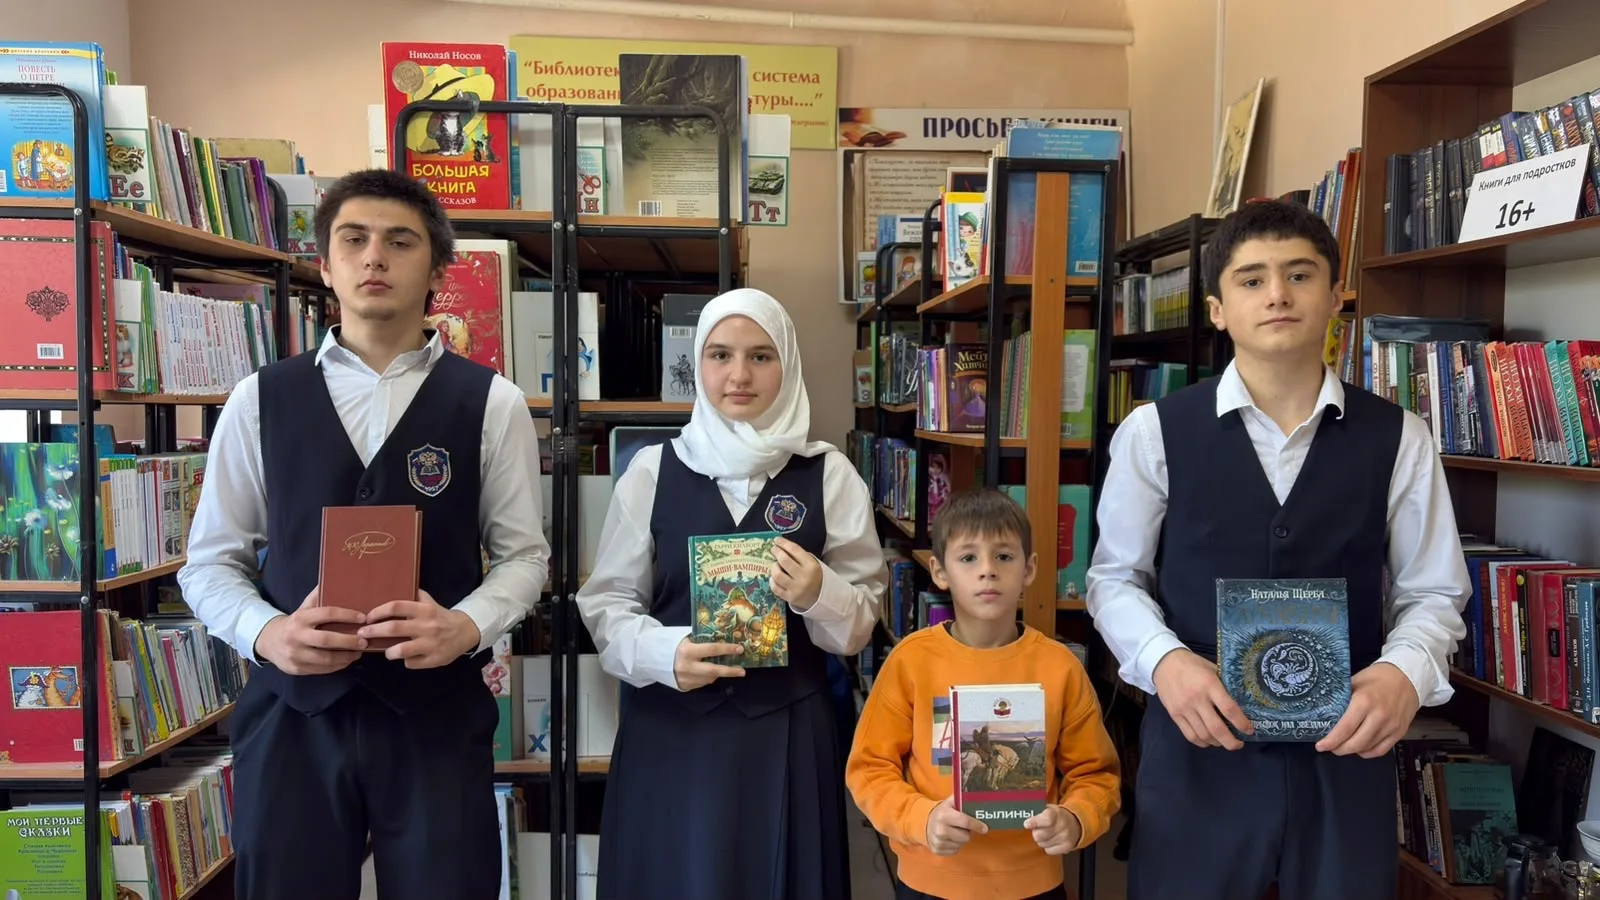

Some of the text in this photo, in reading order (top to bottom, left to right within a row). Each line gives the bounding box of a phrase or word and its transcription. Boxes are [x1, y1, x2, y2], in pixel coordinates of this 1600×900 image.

[409, 50, 482, 61] Николай Носов
[18, 65, 56, 73] ПОВЕСТЬ
[29, 73, 55, 81] ПЕТРЕ
[752, 71, 820, 84] система
[412, 163, 490, 179] БОЛЬШАЯ
[1479, 158, 1576, 191] Книги для подростков
[427, 181, 477, 194] КНИГА
[1495, 200, 1535, 229] 16+
[34, 816, 83, 826] ПЕРВЫЕ
[18, 827, 71, 838] СКАЗКИ
